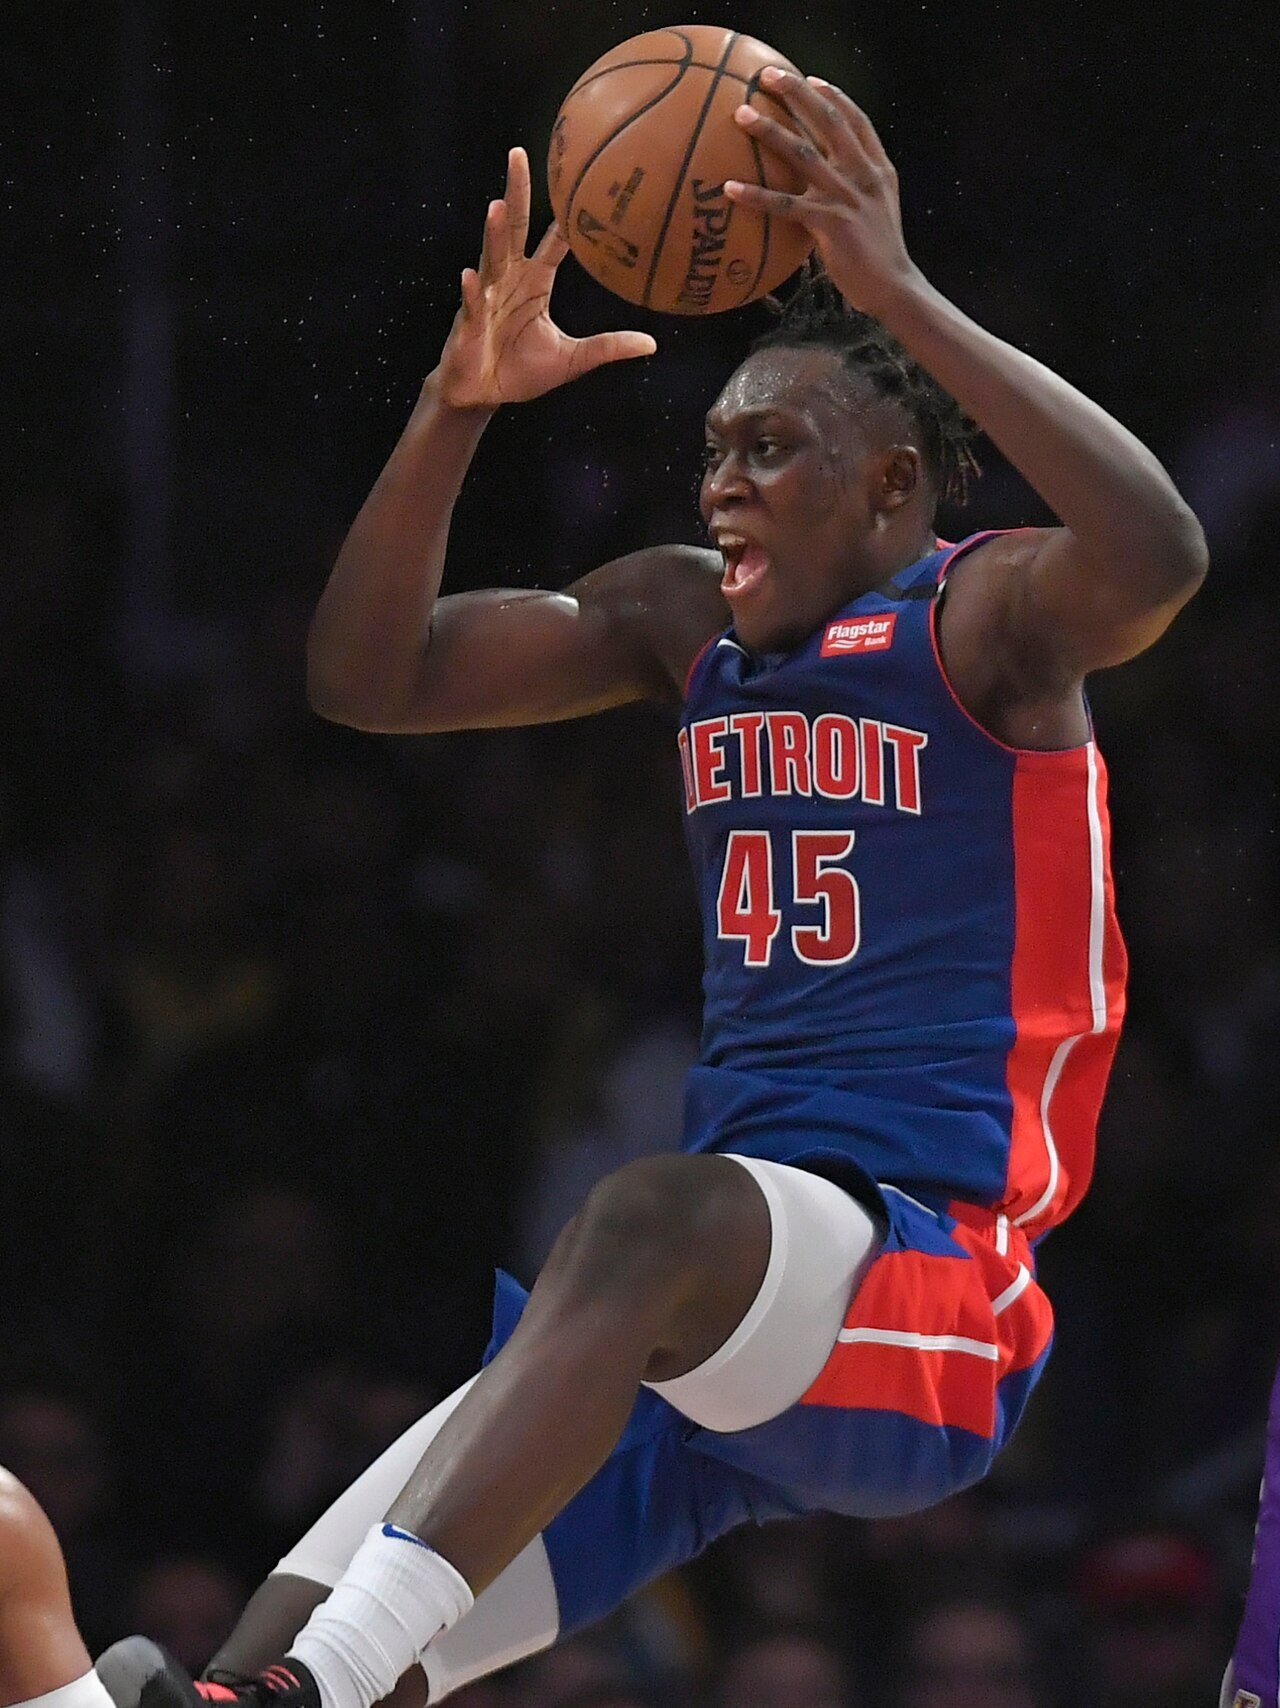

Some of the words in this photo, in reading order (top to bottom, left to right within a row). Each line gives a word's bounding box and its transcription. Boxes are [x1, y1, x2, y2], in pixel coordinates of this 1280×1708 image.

[828, 621, 891, 640] Flagstar
[864, 636, 887, 646] Bank
[717, 830, 860, 967] 45
